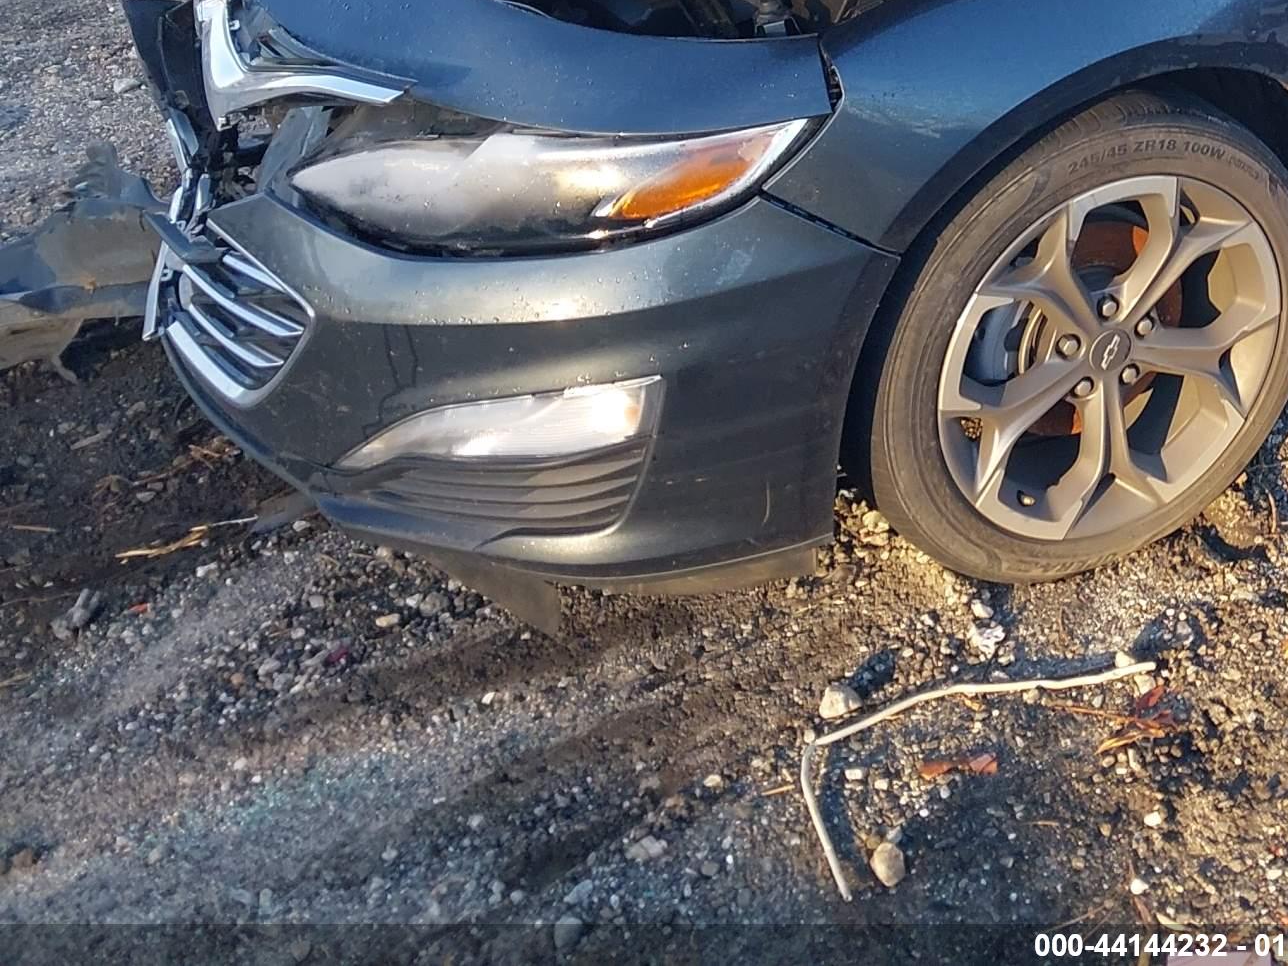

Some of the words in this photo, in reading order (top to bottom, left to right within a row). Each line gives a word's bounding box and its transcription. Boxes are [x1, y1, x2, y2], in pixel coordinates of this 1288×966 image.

[1067, 143, 1128, 175] 245/45
[1132, 139, 1178, 154] ZR18
[1183, 140, 1227, 160] 100W
